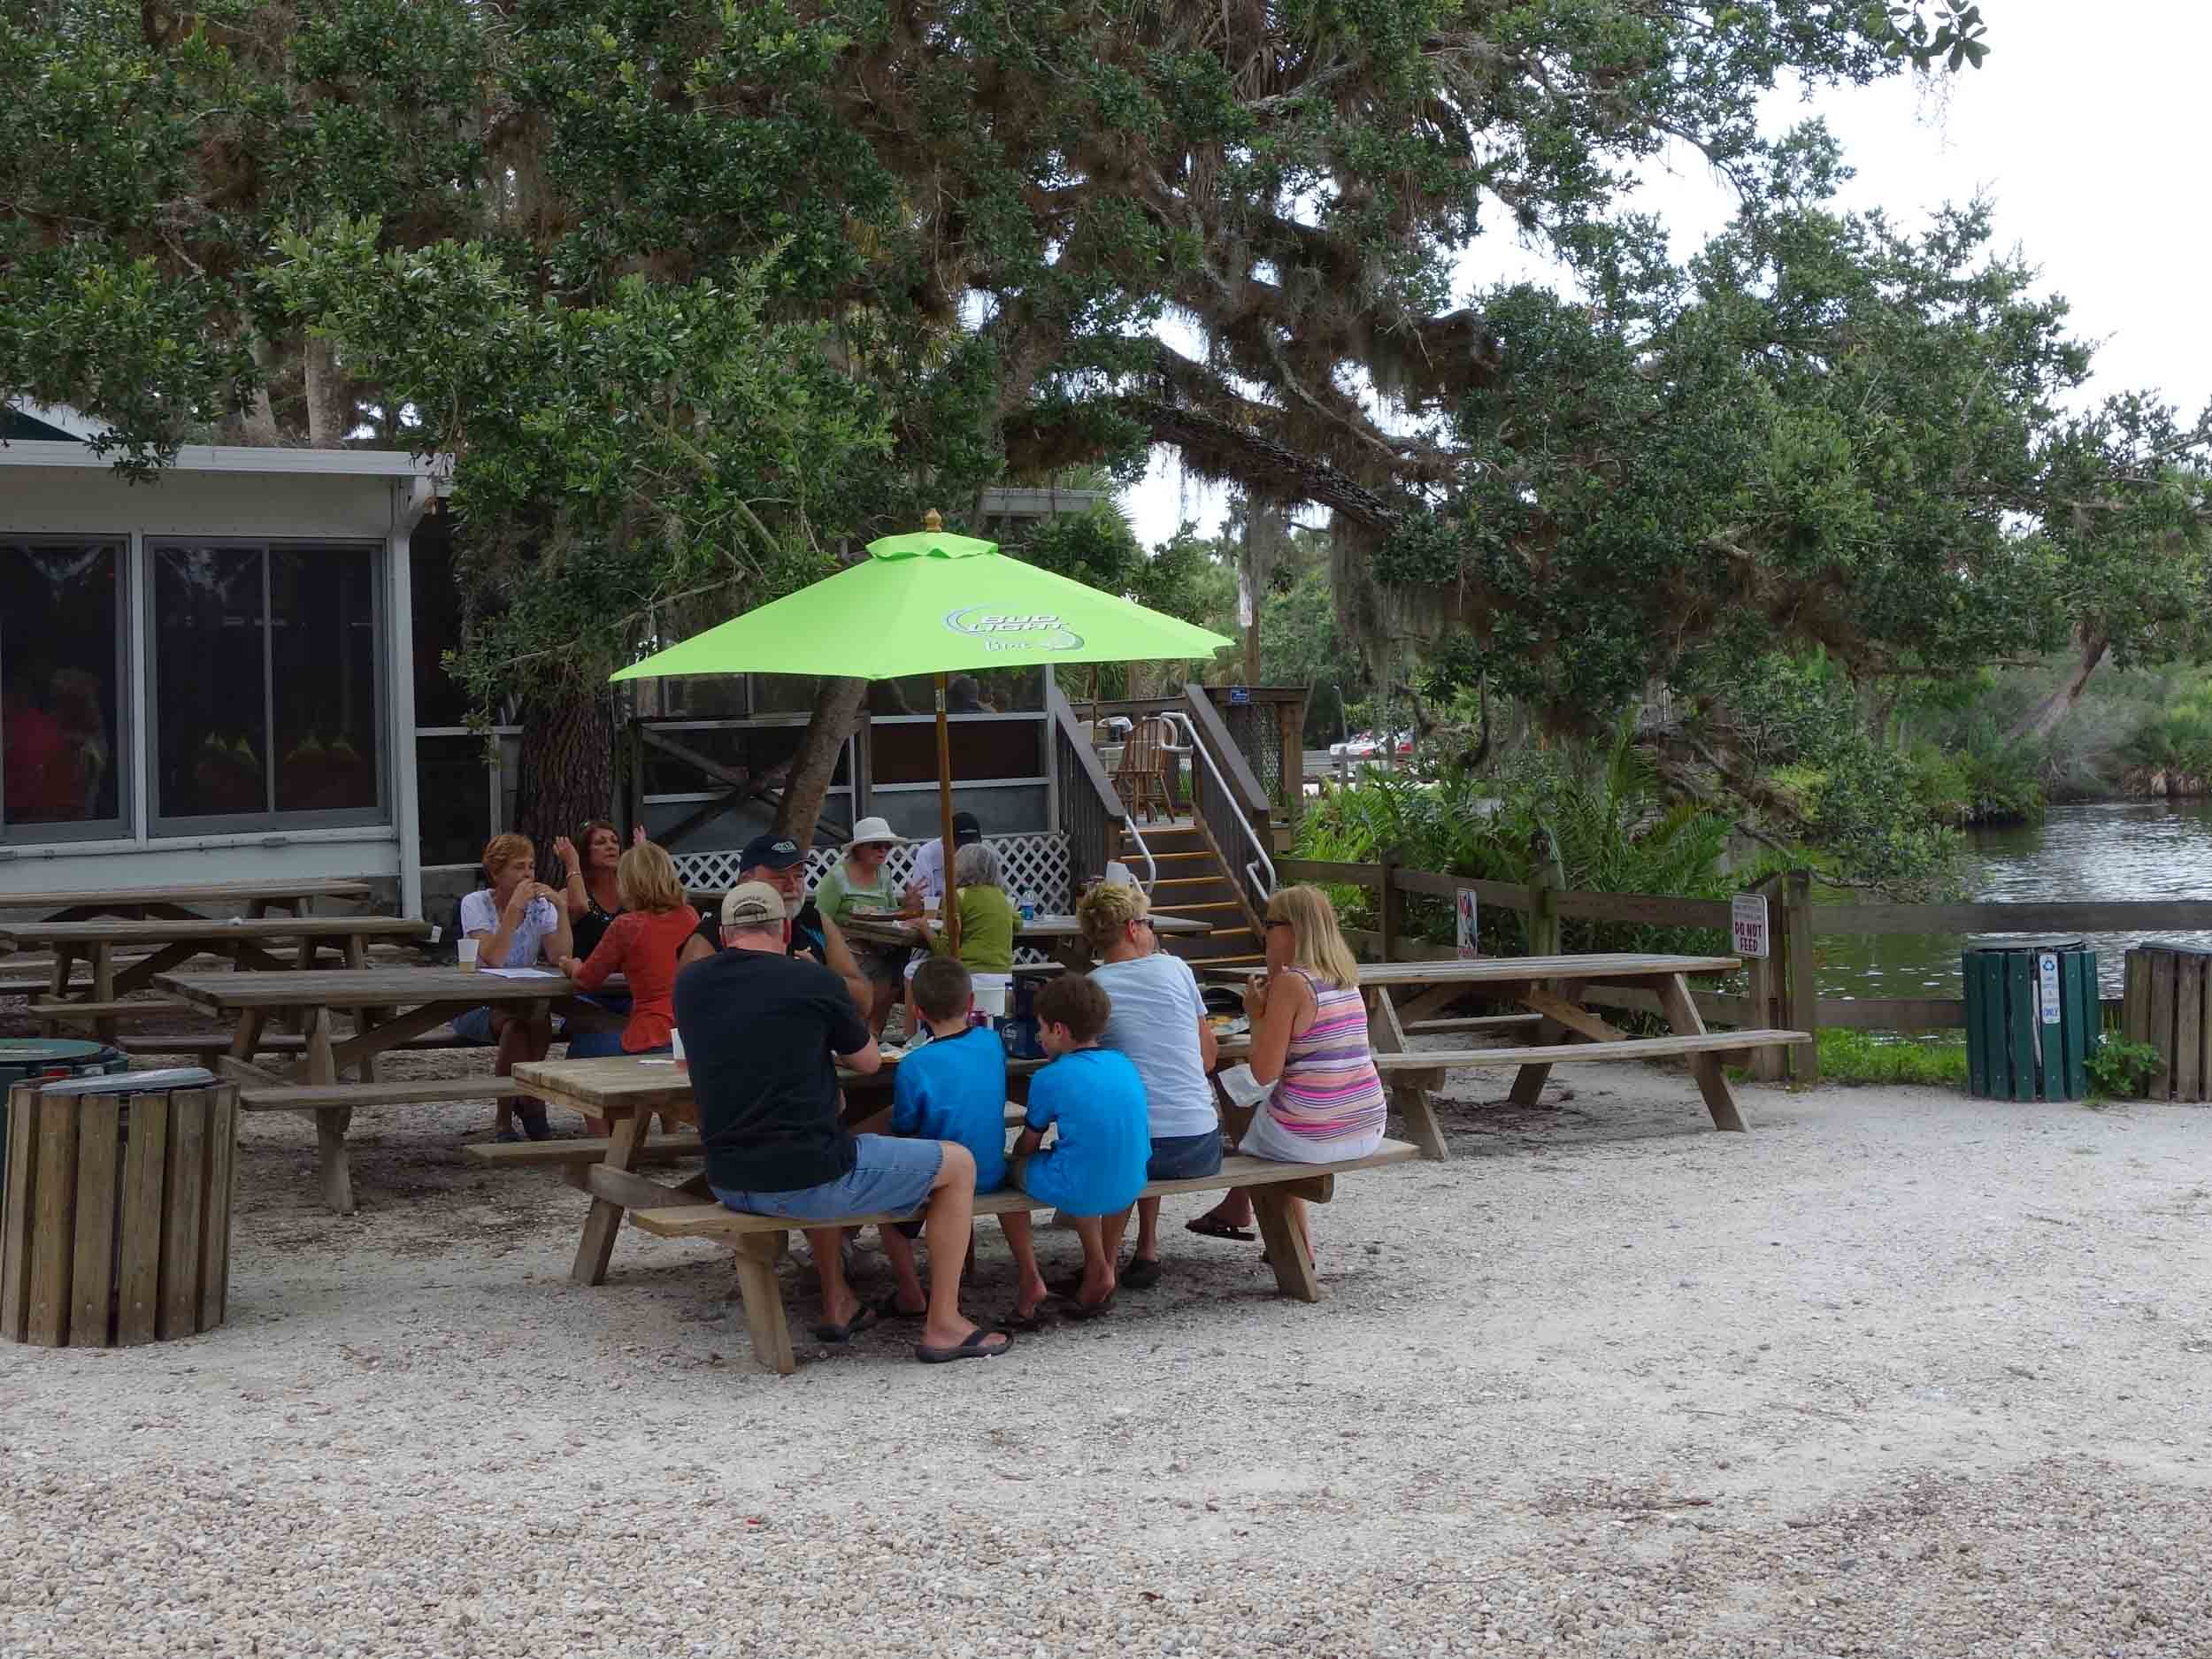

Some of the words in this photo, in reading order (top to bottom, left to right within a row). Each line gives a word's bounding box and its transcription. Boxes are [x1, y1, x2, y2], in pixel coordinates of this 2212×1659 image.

[981, 614, 1062, 624] BUD
[967, 622, 1070, 634] LIGHT
[1735, 921, 1745, 936] DO
[1747, 923, 1762, 938] NOT
[1740, 937, 1758, 952] FEED
